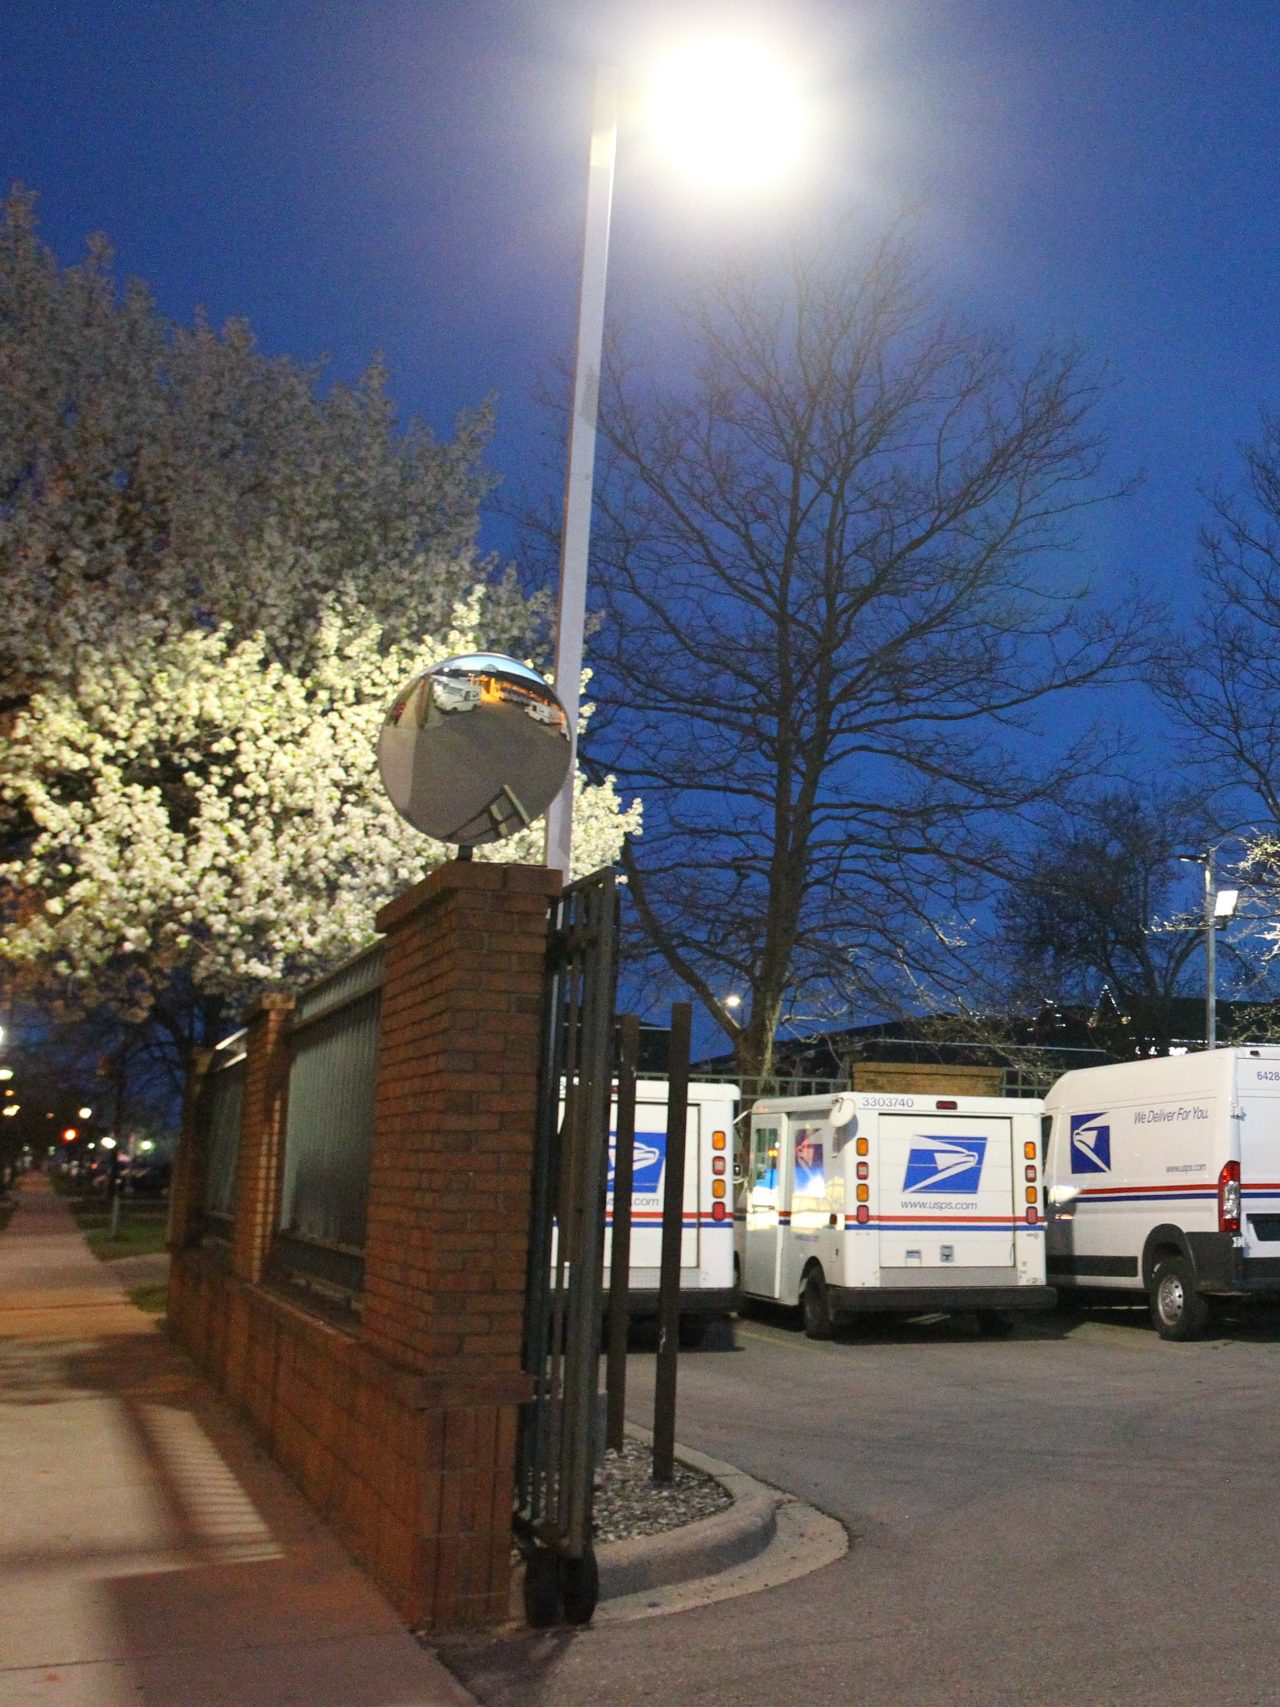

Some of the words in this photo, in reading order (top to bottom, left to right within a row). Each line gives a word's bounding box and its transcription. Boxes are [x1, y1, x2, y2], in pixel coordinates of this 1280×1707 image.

[862, 1096, 914, 1108] 3303740
[1134, 1111, 1147, 1124] We
[1147, 1109, 1176, 1123] Deliver
[1177, 1107, 1192, 1121] For
[1193, 1105, 1209, 1120] You.
[901, 1201, 978, 1211] www.usps.com
